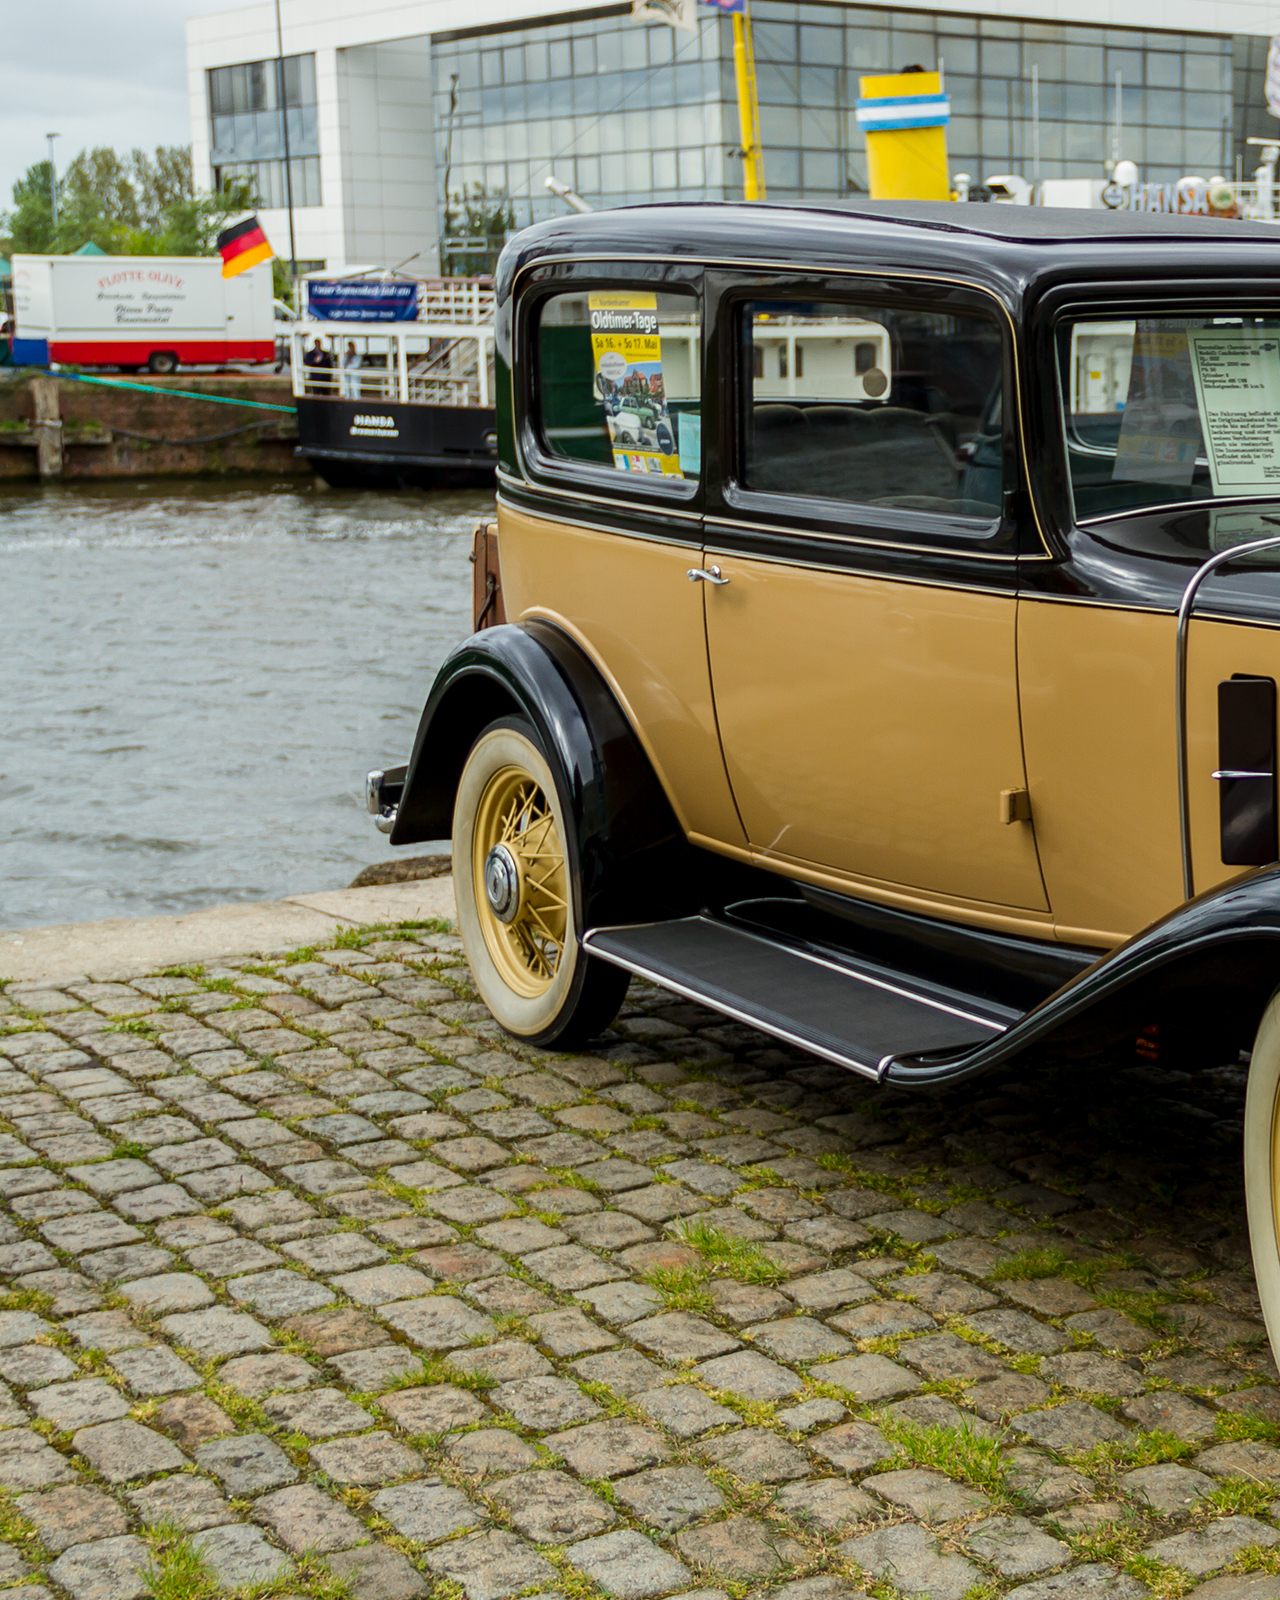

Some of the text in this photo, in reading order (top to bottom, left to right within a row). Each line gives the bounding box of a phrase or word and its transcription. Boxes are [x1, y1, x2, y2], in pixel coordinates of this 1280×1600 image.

[1130, 184, 1208, 213] HANSA
[98, 270, 185, 290] FLOTTE OLIVE
[592, 310, 657, 334] Oldtimer-Tage
[595, 337, 604, 348] Sa
[605, 337, 616, 348] 16.
[624, 338, 632, 348] So
[634, 338, 644, 348] 17.
[645, 338, 658, 349] Mai
